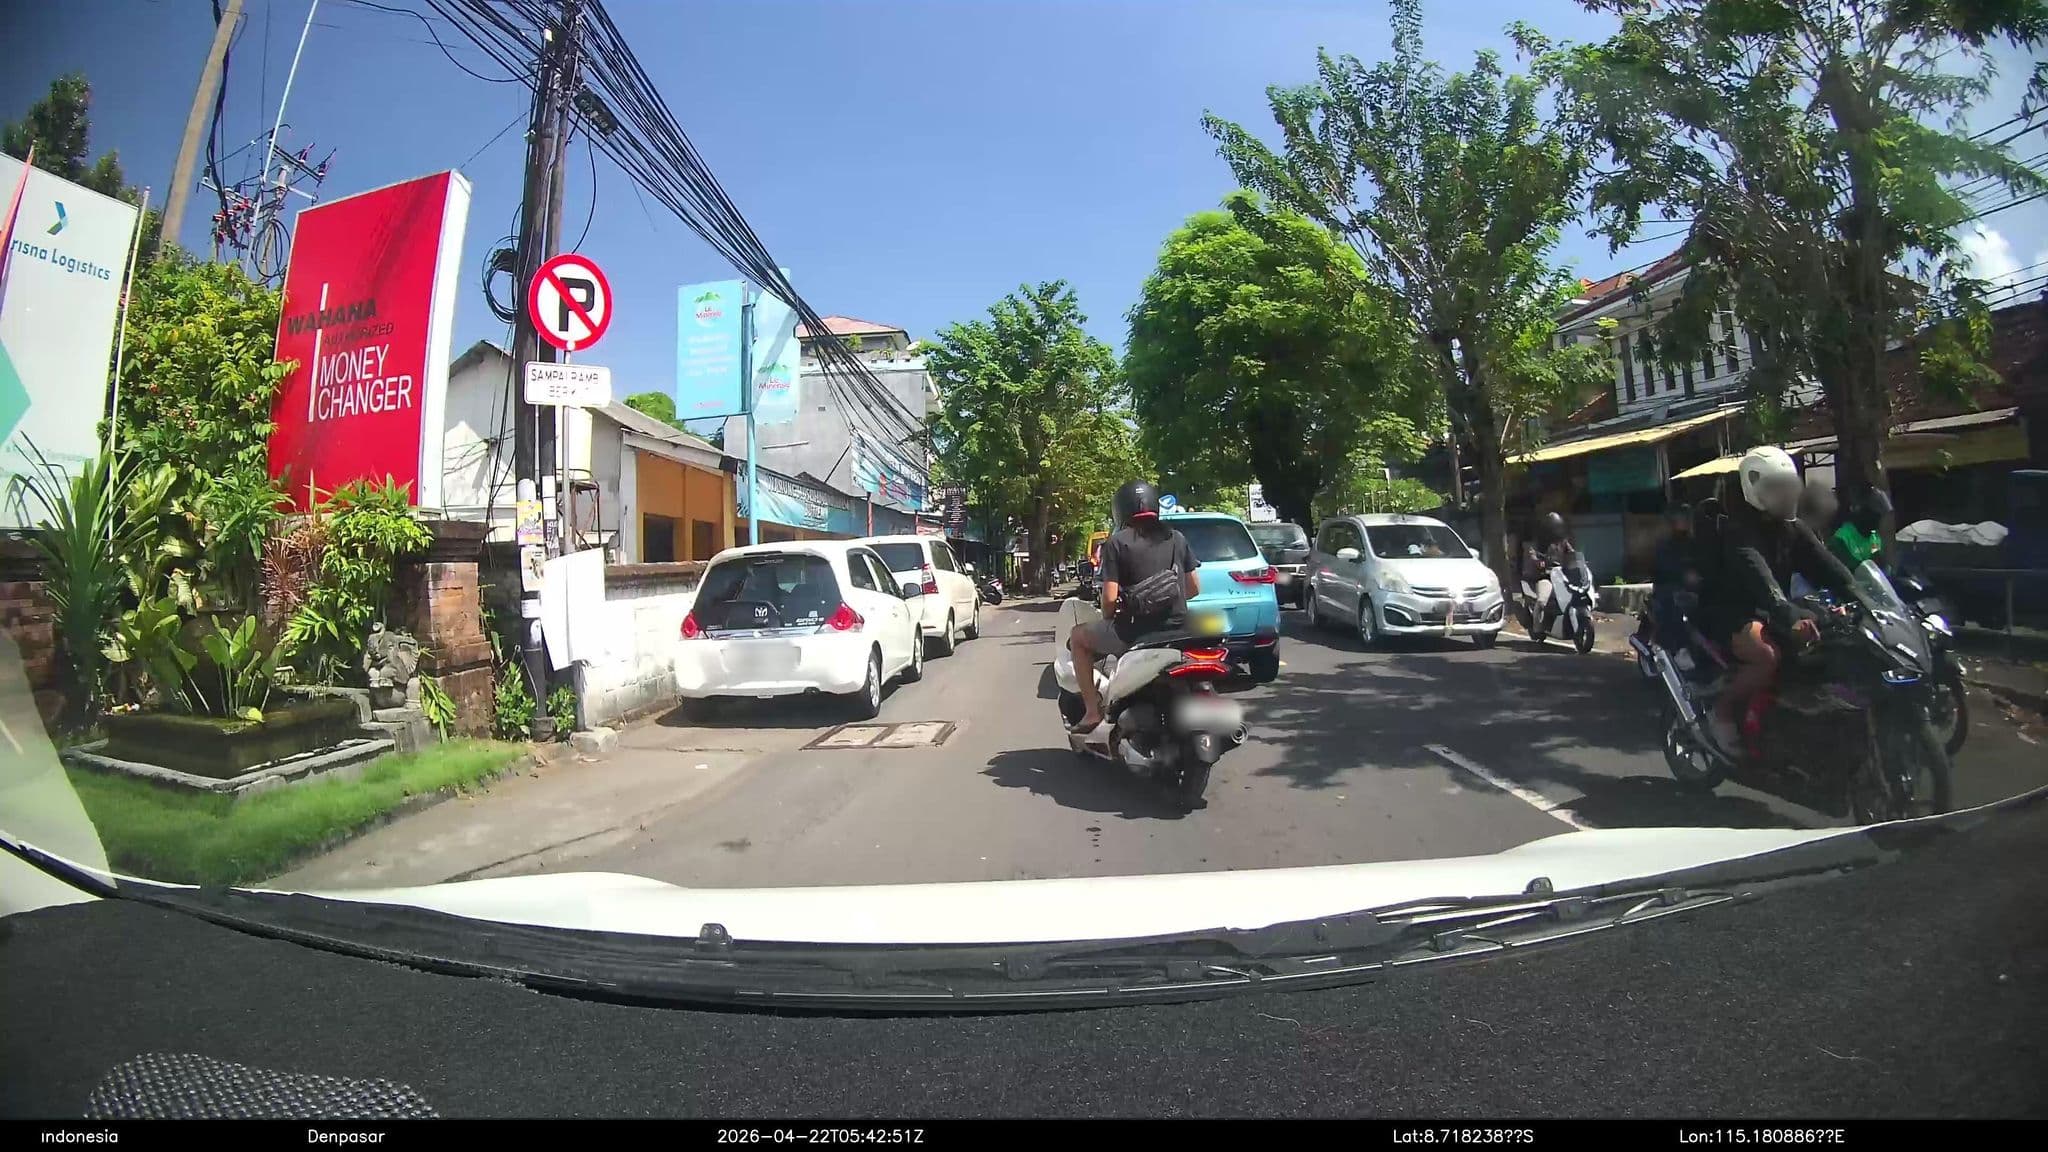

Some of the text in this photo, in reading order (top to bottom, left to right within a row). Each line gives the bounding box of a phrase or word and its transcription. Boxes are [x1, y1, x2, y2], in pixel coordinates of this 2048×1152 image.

[51, 247, 111, 281] Logistics
[287, 298, 377, 335] WAHANA
[324, 323, 395, 346] AURIZED
[320, 344, 389, 387] MONEY
[318, 375, 412, 420] CHANGER
